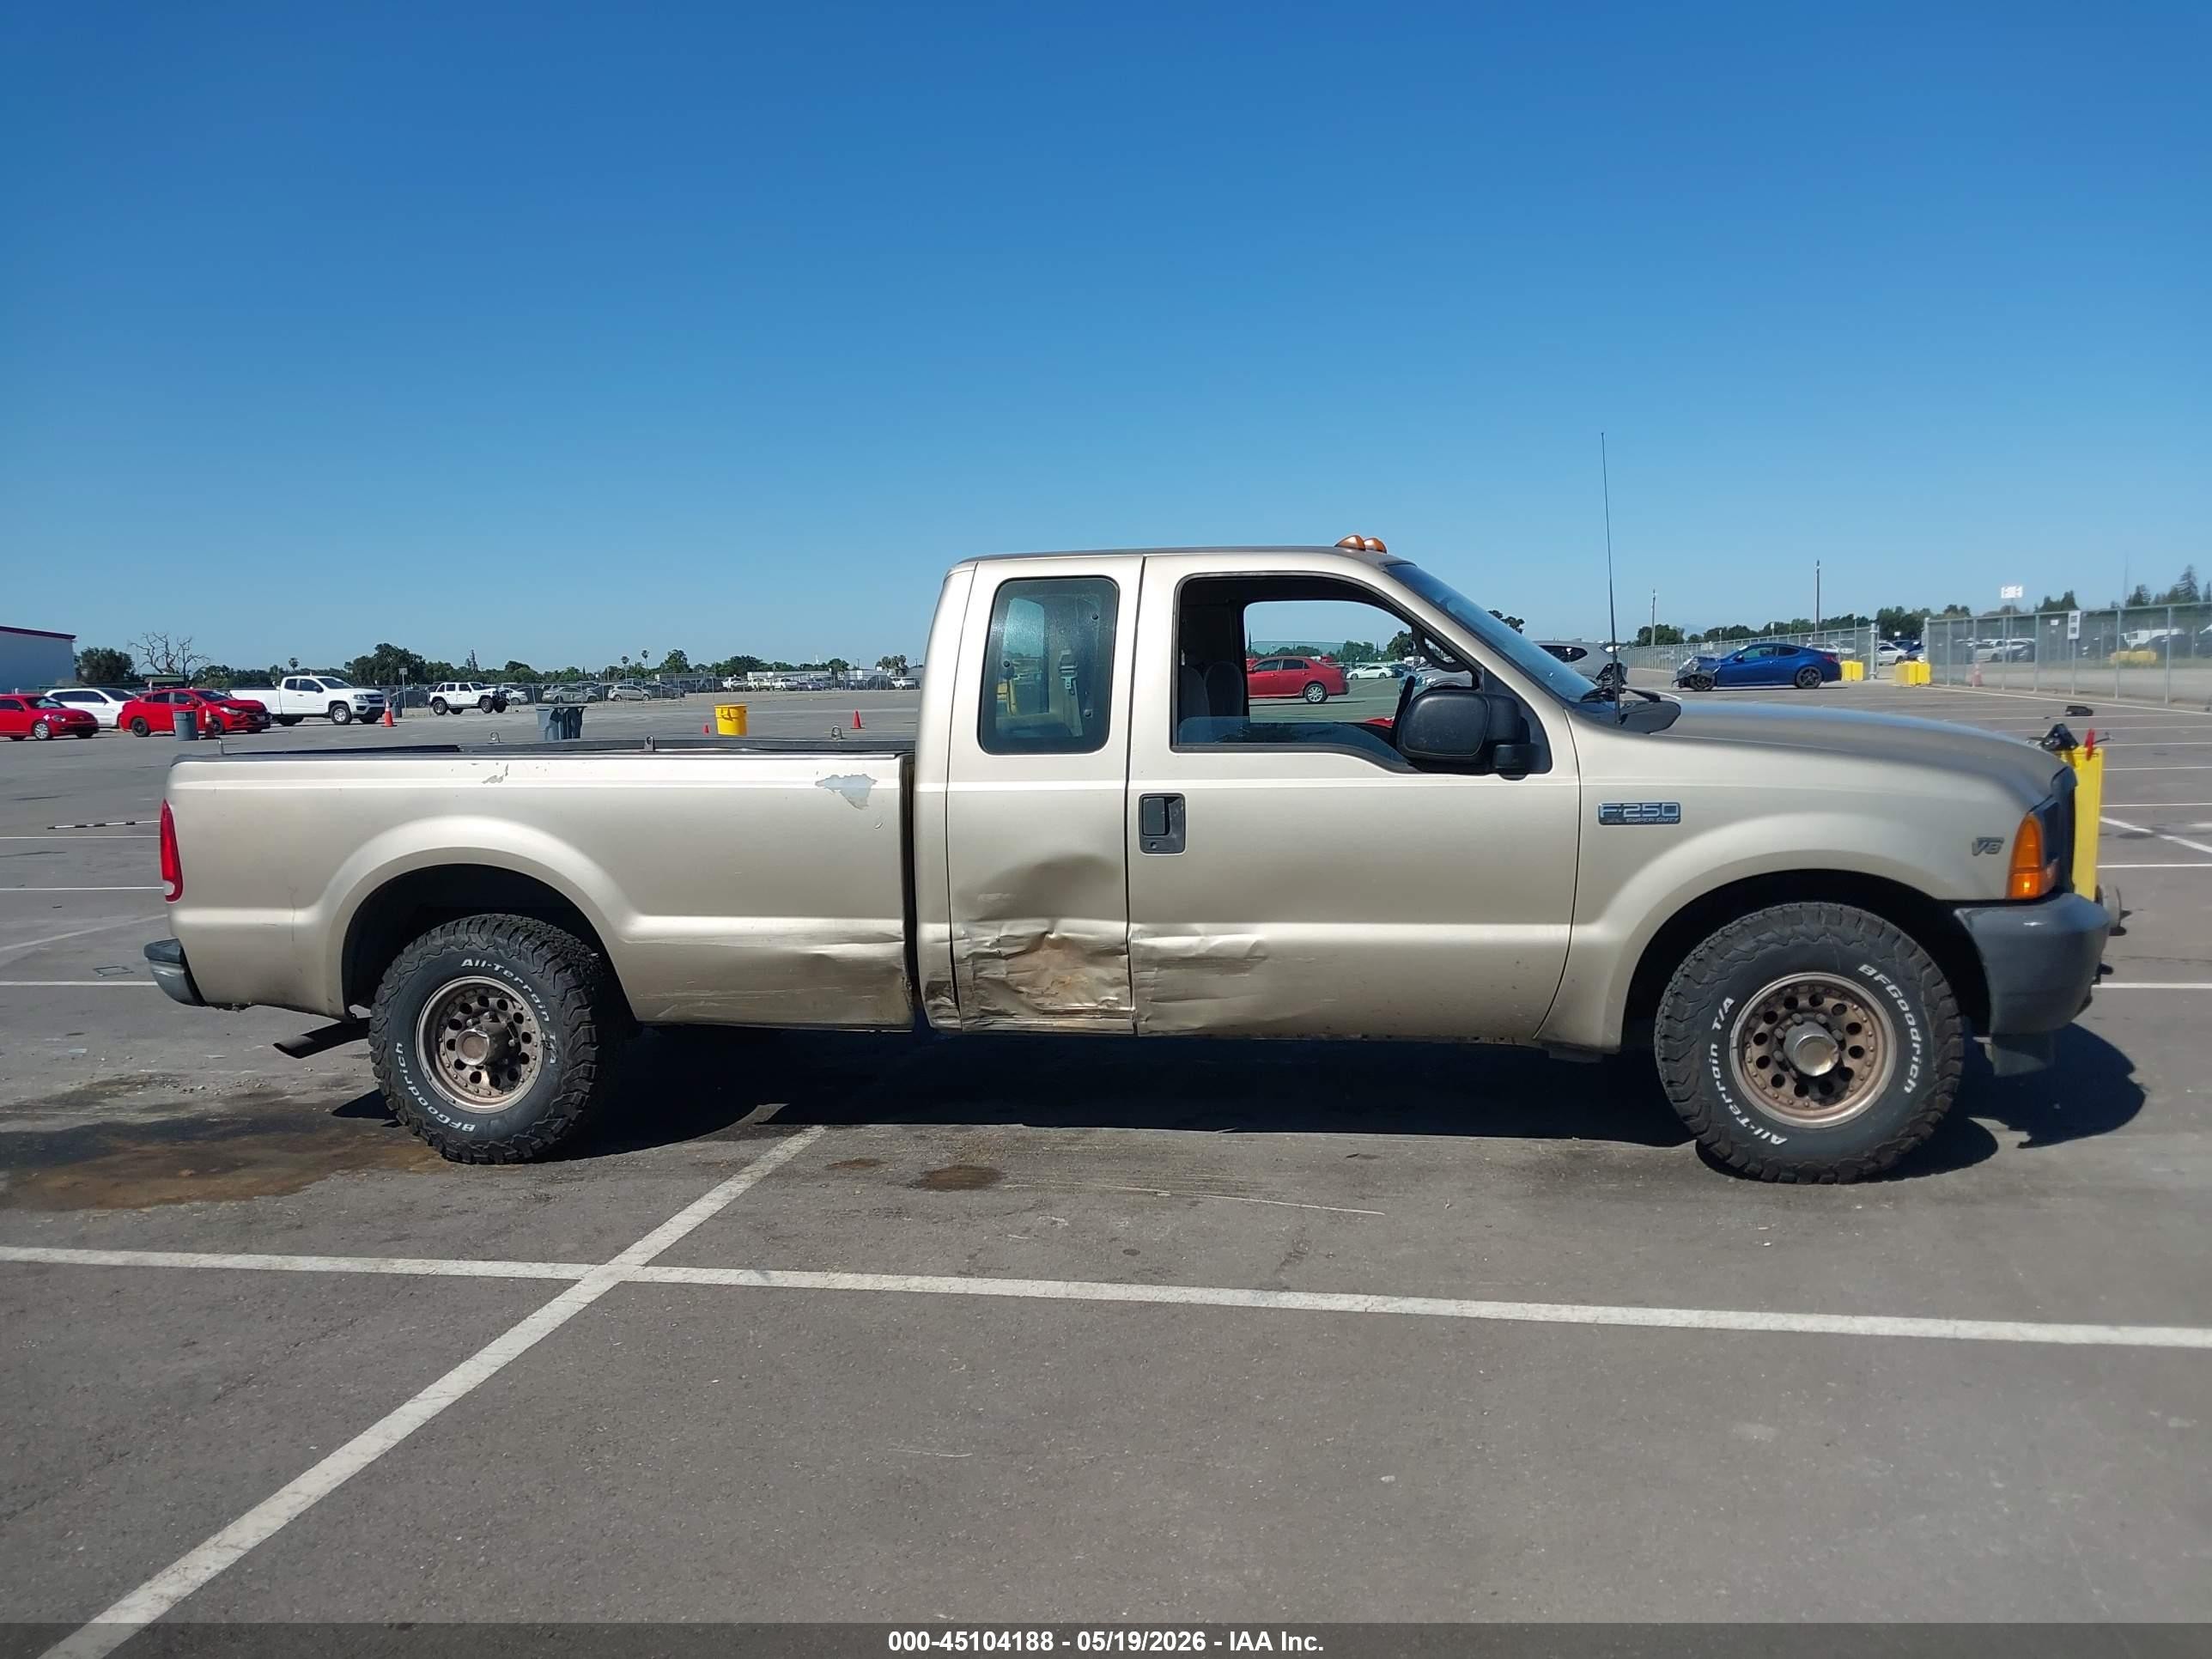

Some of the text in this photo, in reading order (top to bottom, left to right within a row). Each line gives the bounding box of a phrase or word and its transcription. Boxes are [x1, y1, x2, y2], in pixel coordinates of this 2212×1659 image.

[461, 957, 550, 1022] All-Terrain
[1858, 963, 1923, 1094] BFGoodrich
[394, 1042, 477, 1133] BFGoodrich
[1710, 996, 1788, 1146] All-Terrain T/A
